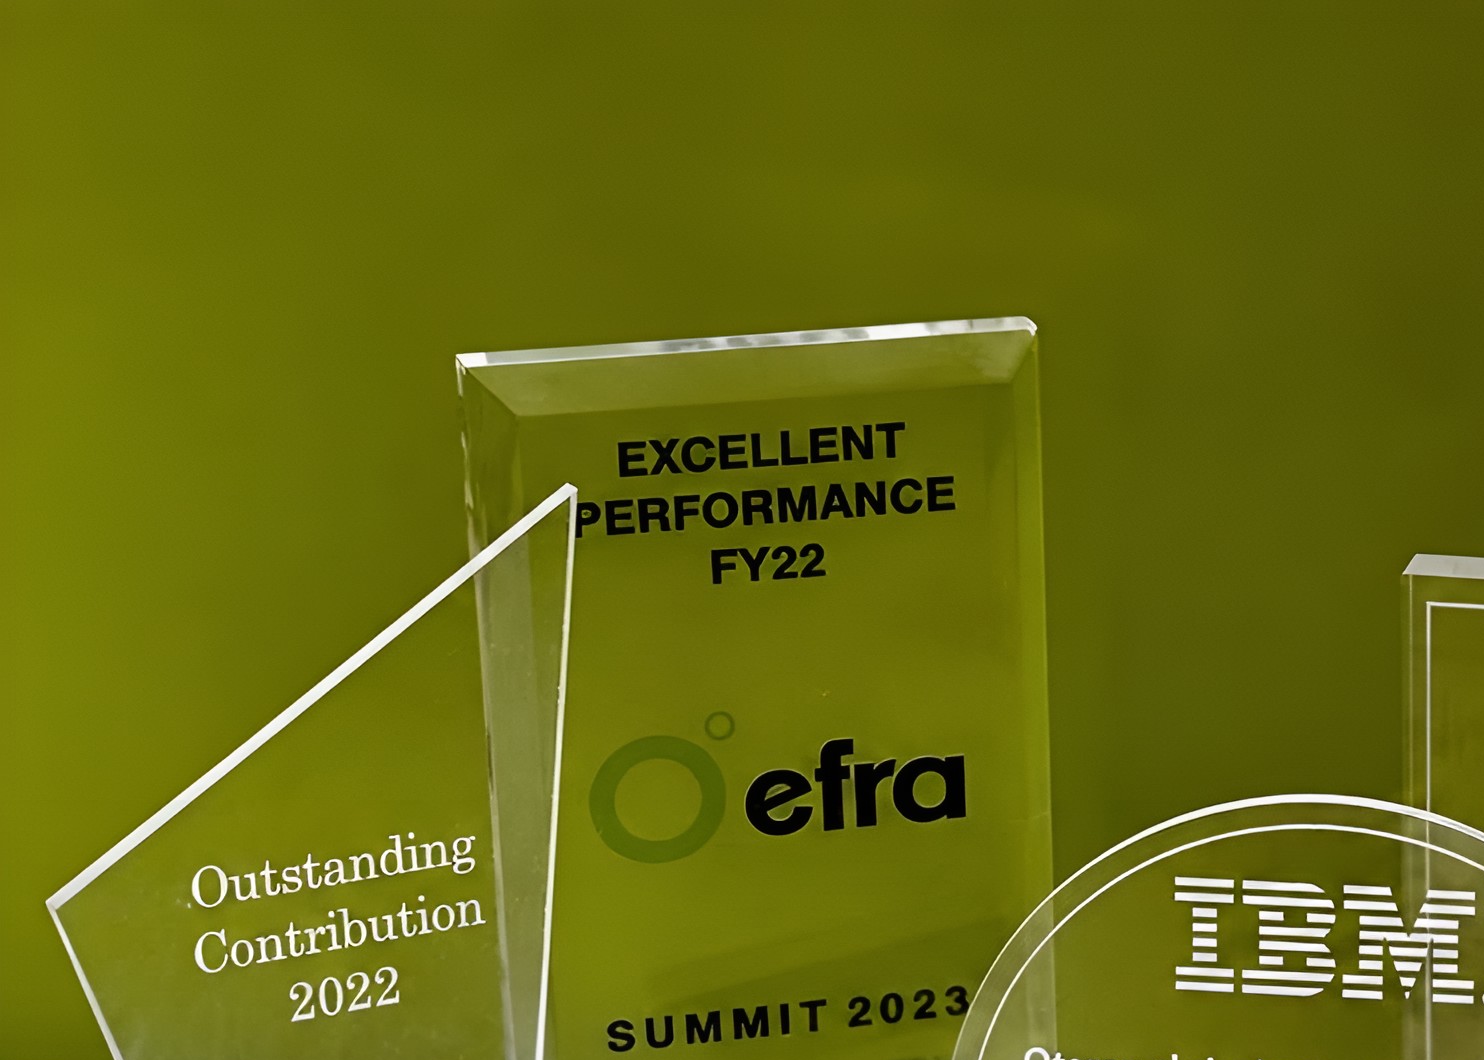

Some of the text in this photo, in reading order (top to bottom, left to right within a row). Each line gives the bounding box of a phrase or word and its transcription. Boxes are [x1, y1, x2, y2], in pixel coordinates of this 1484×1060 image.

[617, 421, 906, 478] EXCELLENT
[575, 476, 956, 539] PERFORMANCE
[710, 543, 827, 585] FY22
[744, 737, 967, 837] efra
[190, 831, 477, 909] Outstanding
[193, 895, 487, 974] Contribution
[1174, 876, 1477, 1005] IBM
[288, 966, 400, 1023] 2022
[605, 984, 970, 1053] SUMMIT 2023
